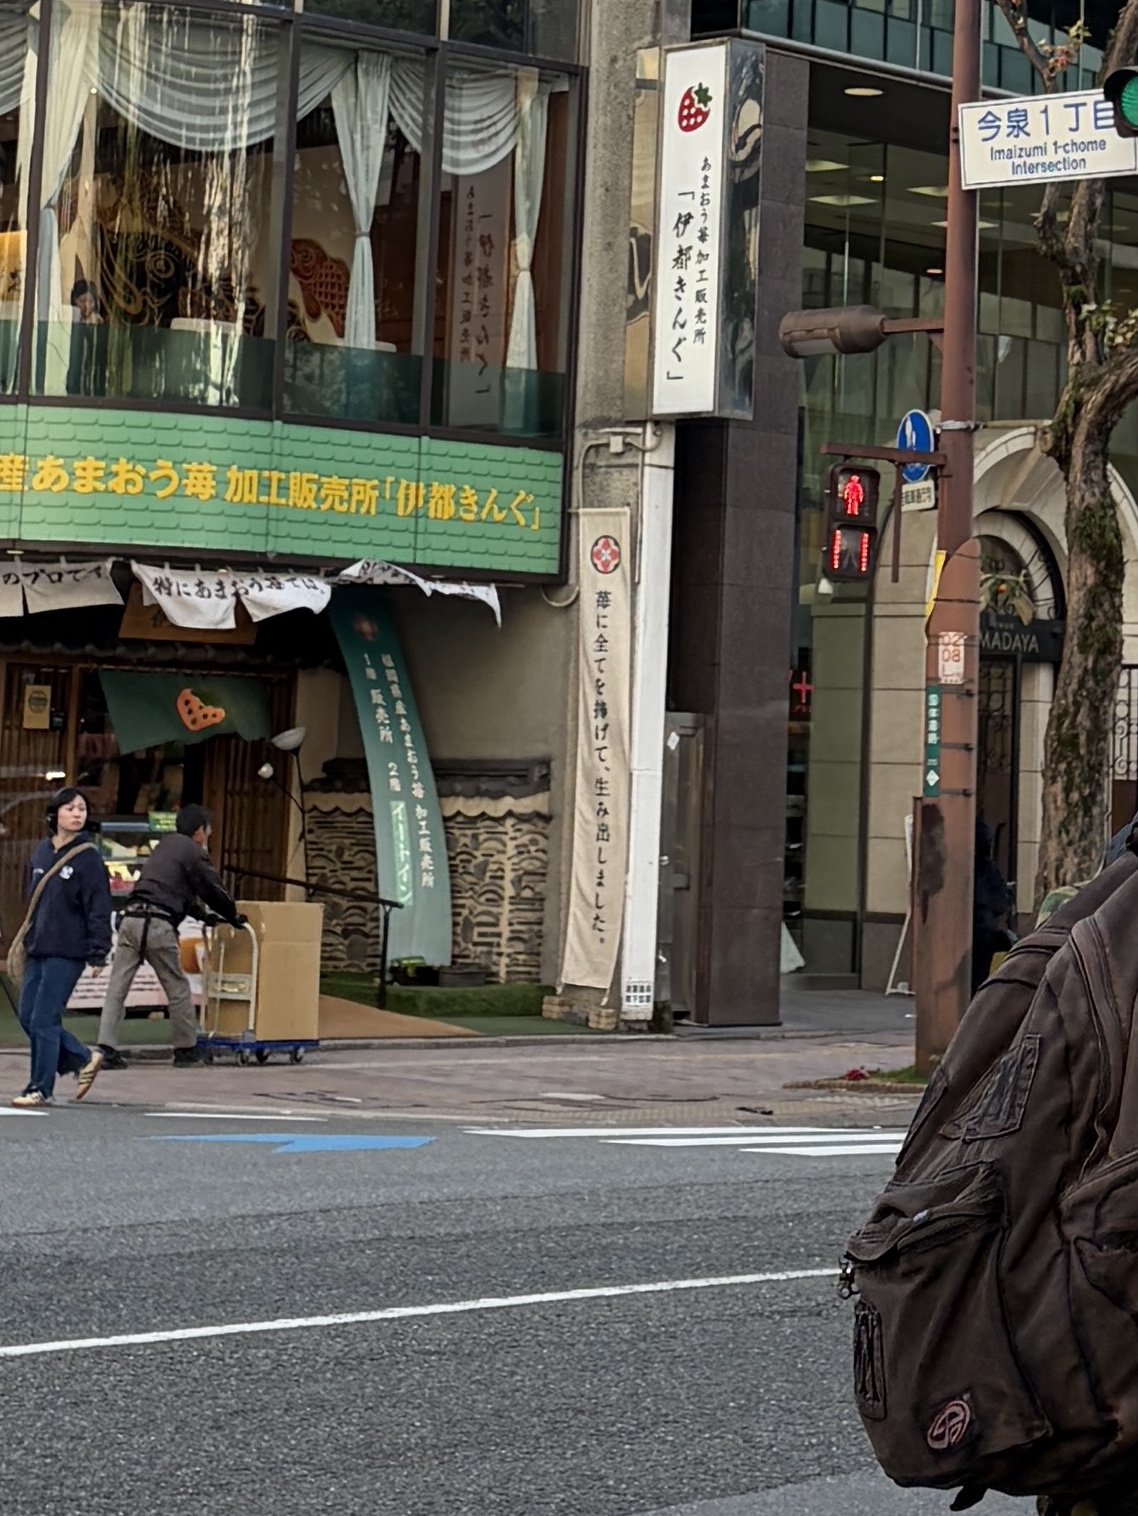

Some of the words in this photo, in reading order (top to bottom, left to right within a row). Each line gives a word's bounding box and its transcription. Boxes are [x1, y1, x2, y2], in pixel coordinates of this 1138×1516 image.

[978, 101, 1114, 142] 今泉1丁目
[990, 142, 1047, 161] Imaizumi
[1053, 138, 1107, 156] 1-chome
[1012, 157, 1087, 175] Intersection
